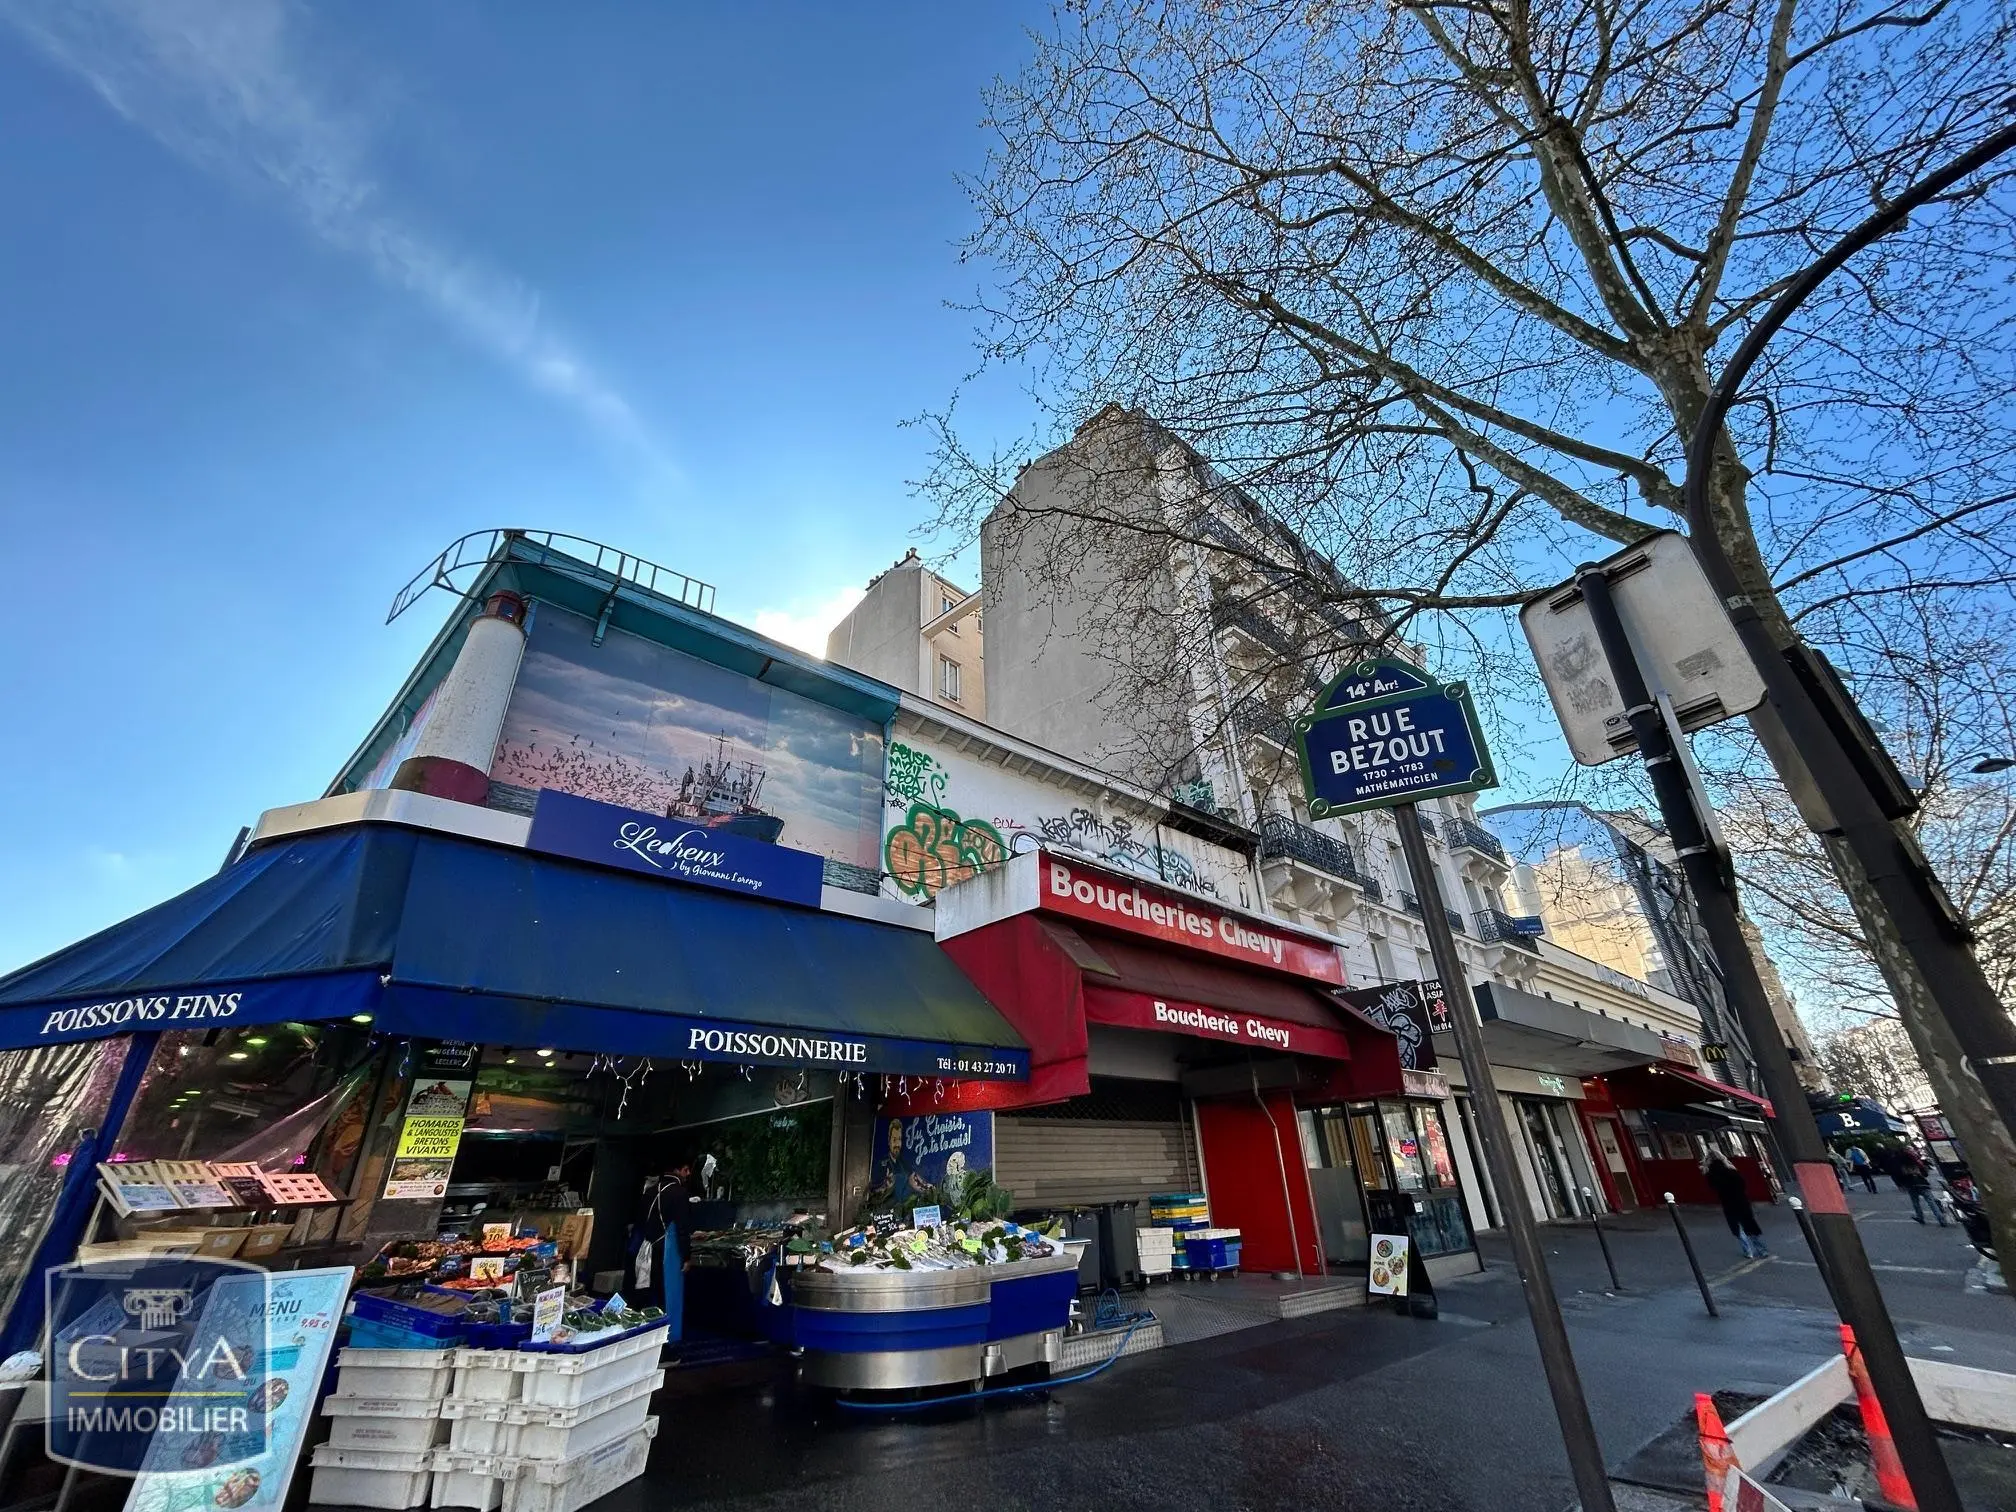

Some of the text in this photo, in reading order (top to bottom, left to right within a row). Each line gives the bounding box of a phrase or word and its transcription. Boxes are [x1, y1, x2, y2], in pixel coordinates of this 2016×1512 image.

[1348, 707, 1416, 742] RUE
[1330, 728, 1445, 775] BEZOUT
[1355, 772, 1439, 796] MATHÉMATICIEN
[1363, 769, 1388, 781] 1730
[1399, 761, 1424, 774] 1783
[613, 821, 726, 870] Ledreux
[679, 859, 763, 891] by Giovanni Lorenzo
[1050, 862, 1214, 938] Boucheries
[1218, 916, 1283, 964] Chevy
[40, 992, 243, 1034] POISSONS FINS
[1153, 1001, 1290, 1048] Boucherie Chevy
[687, 1028, 867, 1064] POISSONNERIE
[936, 1057, 951, 1070] Tél
[958, 1060, 969, 1071] 01
[971, 1061, 982, 1072] 43
[983, 1062, 994, 1073] 27
[995, 1062, 1006, 1074] 20
[1006, 1063, 1016, 1074] 71
[407, 1128, 460, 1137] & LANGOUSTES
[410, 1120, 461, 1128] HOMARDS
[406, 1145, 452, 1155] VIVANTS
[414, 1137, 449, 1146] BRETONS
[249, 1299, 303, 1318] MENU
